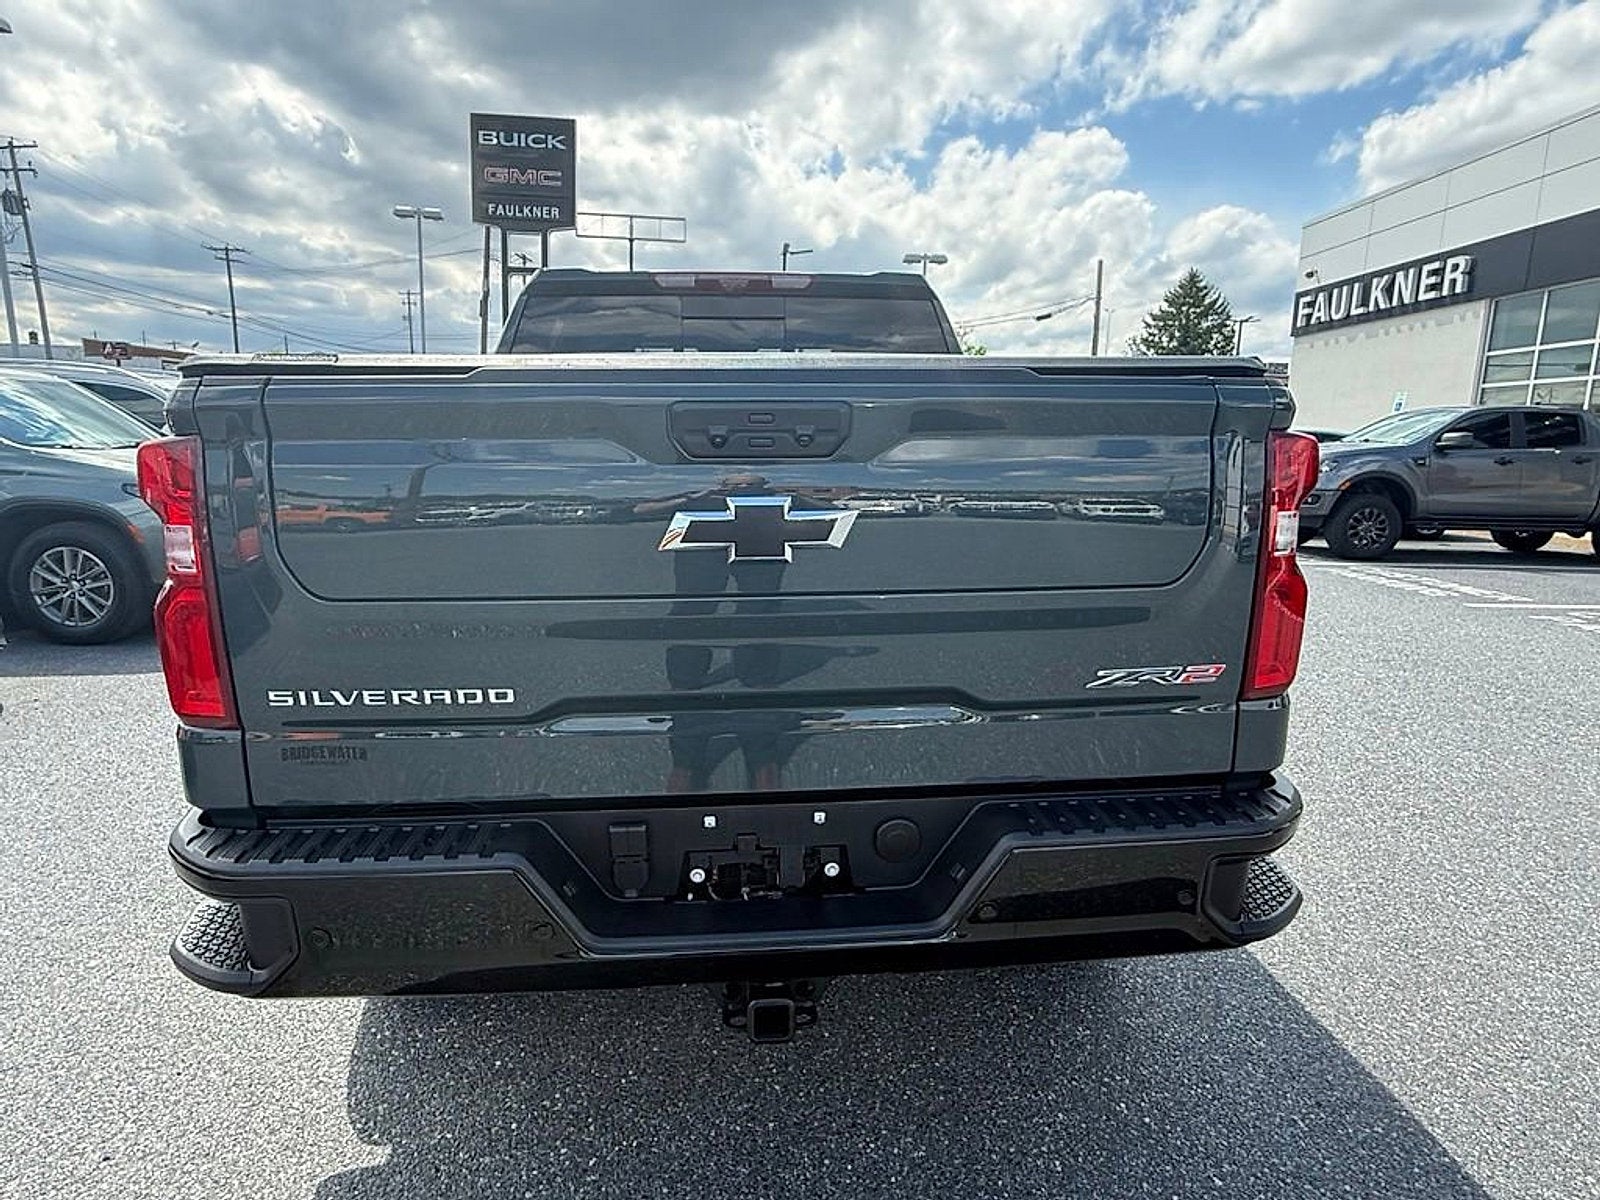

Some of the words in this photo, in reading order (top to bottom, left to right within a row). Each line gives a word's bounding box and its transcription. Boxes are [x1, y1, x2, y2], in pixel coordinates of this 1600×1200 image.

[477, 130, 567, 150] BUICK
[484, 167, 562, 187] GMC
[488, 203, 560, 219] FAULKNER
[1296, 255, 1475, 328] FAULKNER
[1085, 663, 1227, 689] ZR2
[267, 688, 516, 707] SILVERADO
[281, 745, 368, 761] BRIDGEWATER
